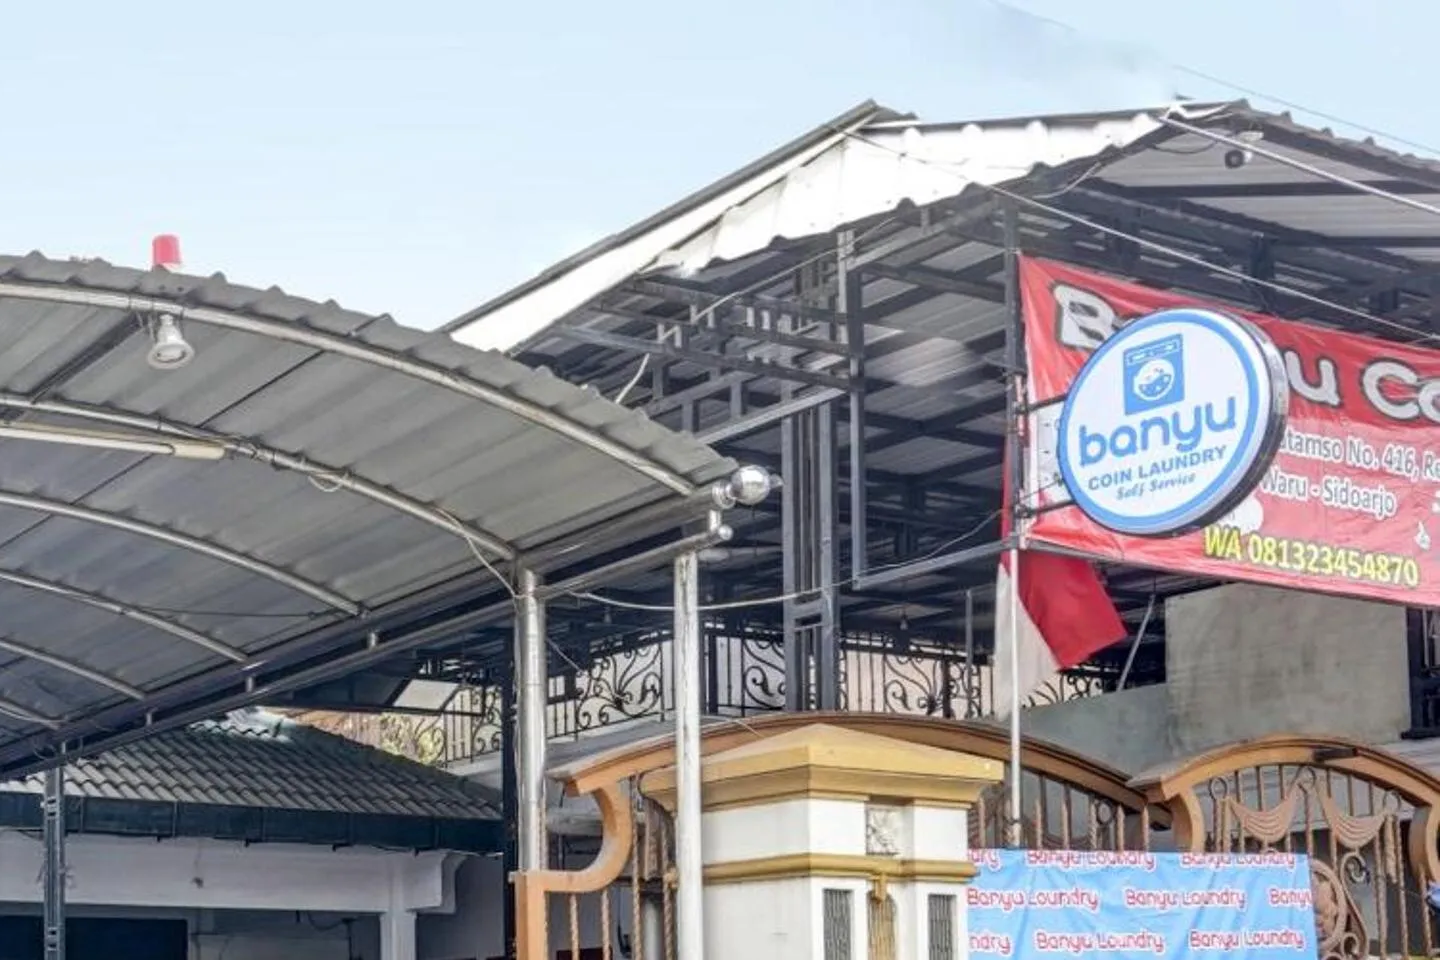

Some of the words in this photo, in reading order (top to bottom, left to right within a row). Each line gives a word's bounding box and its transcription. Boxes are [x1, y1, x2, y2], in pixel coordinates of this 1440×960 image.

[1078, 396, 1237, 467] banyu
[1087, 467, 1132, 491] COIN
[1138, 444, 1227, 479] LAUNDRY
[1348, 438, 1378, 466] No.
[1384, 446, 1419, 479] 416,
[1116, 481, 1146, 501] Self
[1149, 471, 1197, 493] Service
[1324, 477, 1395, 515] Sidoarjo
[1204, 526, 1242, 560] WA
[1248, 534, 1419, 587] 081323454870
[967, 888, 1024, 911] Banyu
[1027, 887, 1099, 910] Laundry
[1125, 888, 1177, 910] Banyu
[1182, 887, 1245, 908] Laundry
[1036, 932, 1093, 953] Banyu
[1097, 931, 1163, 952] Laundry
[1190, 931, 1239, 950] Banyu
[1244, 929, 1303, 949] Laundry
